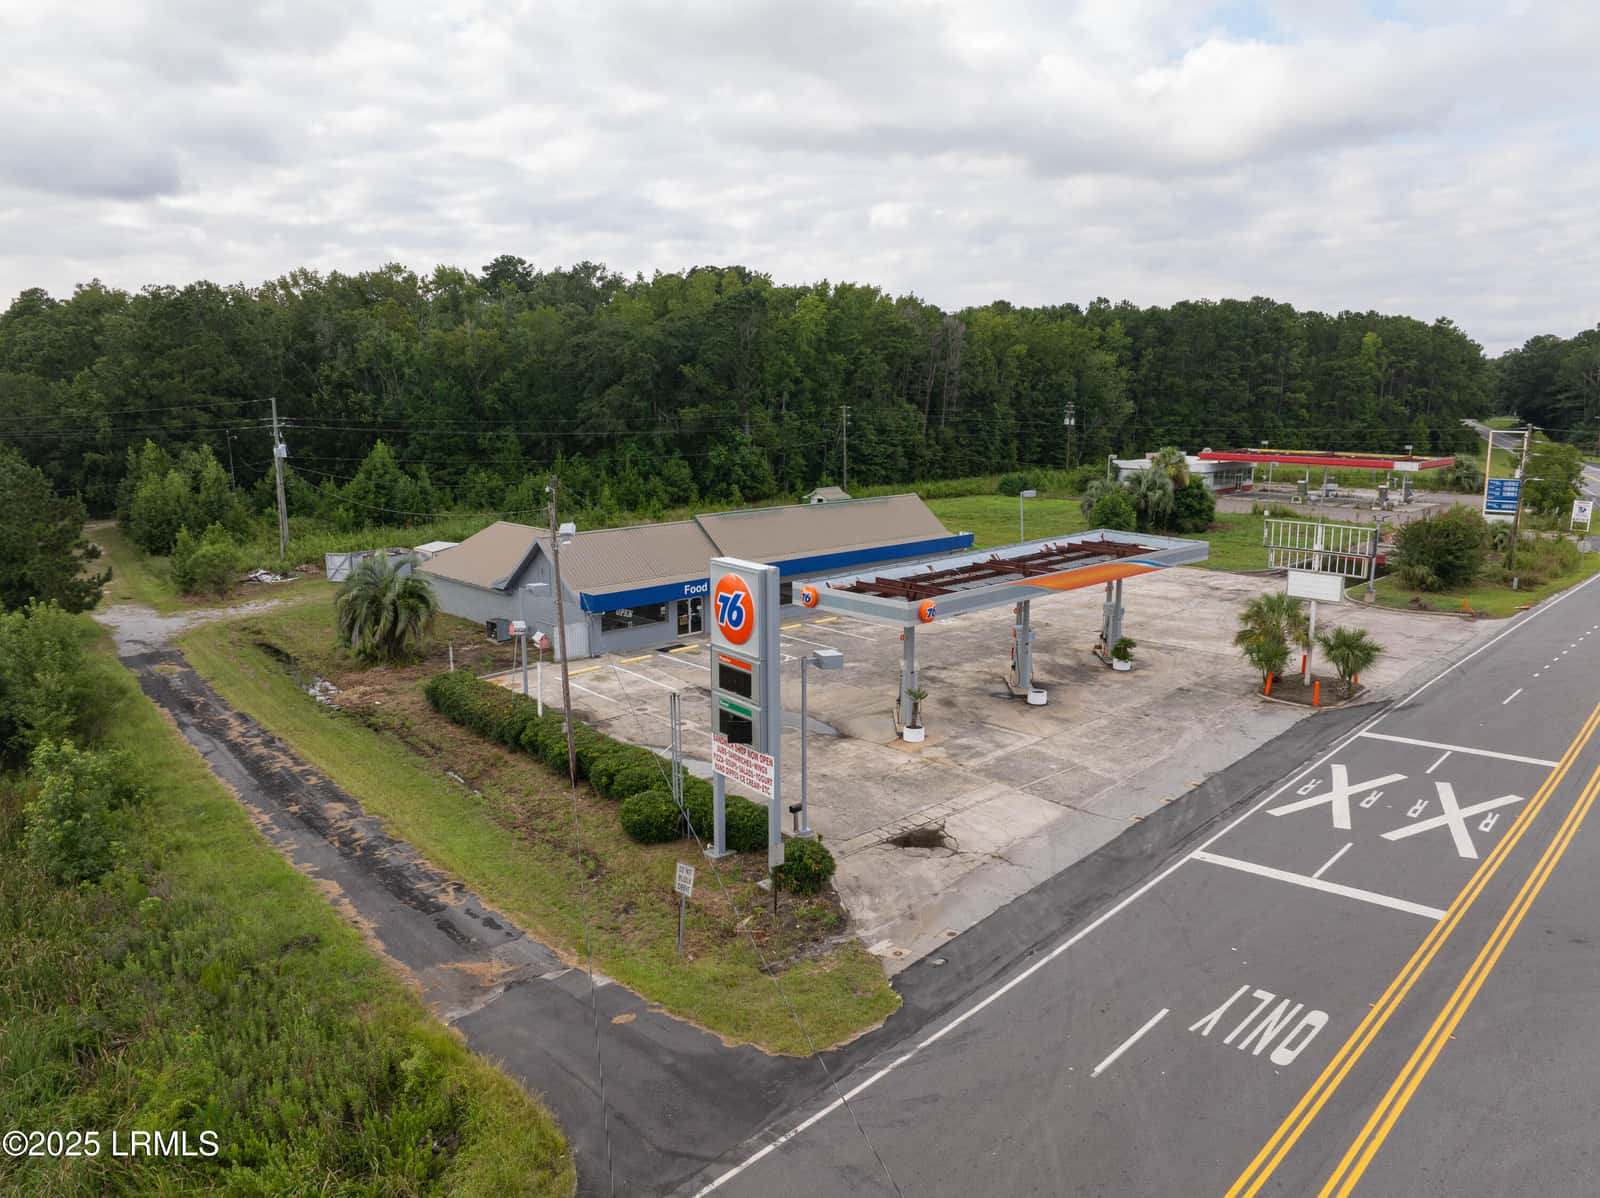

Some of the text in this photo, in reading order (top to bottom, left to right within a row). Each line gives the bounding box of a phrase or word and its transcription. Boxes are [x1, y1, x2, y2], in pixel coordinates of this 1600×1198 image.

[684, 582, 708, 595] Food
[717, 590, 746, 630] 76
[760, 754, 774, 767] OPEN
[1188, 984, 1329, 1066] ONLY
